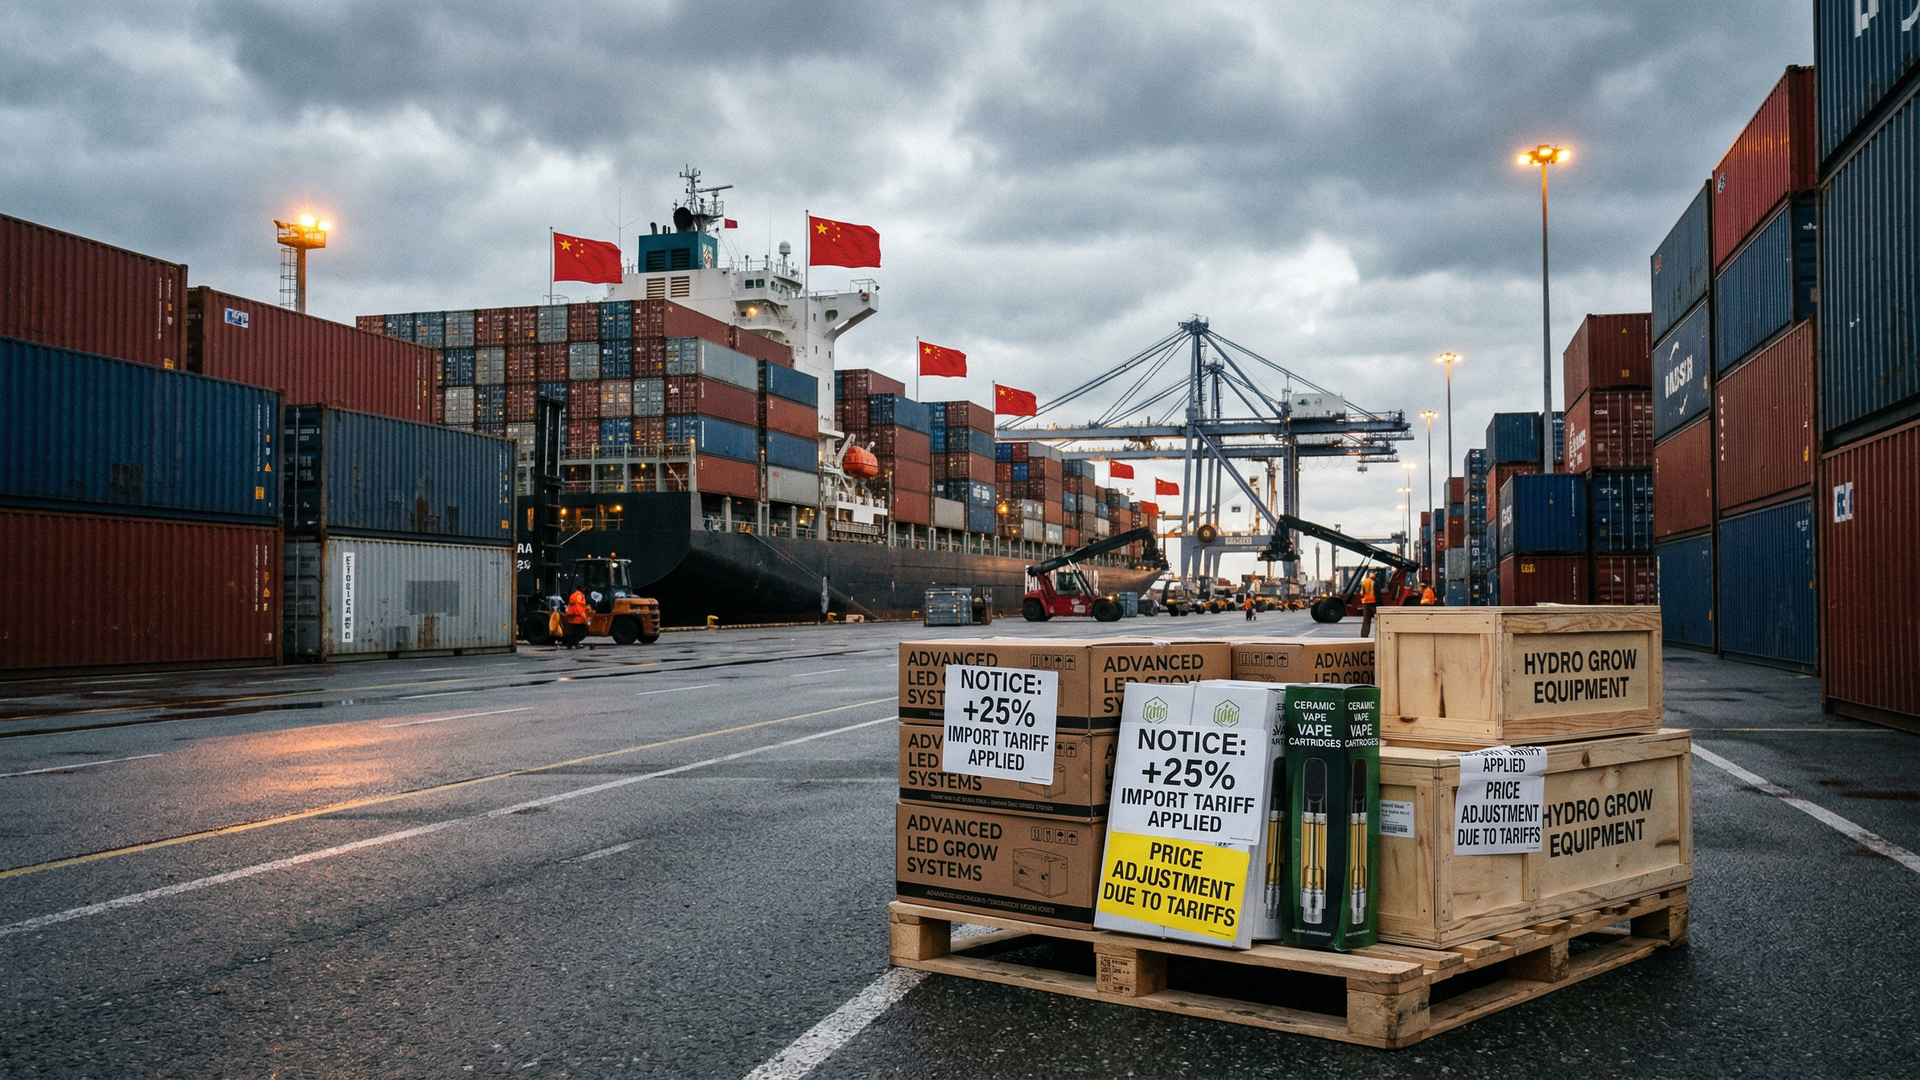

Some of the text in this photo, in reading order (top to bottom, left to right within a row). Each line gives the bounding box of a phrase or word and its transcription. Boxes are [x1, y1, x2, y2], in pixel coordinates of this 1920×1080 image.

[907, 651, 998, 667] ADVANCED
[1103, 654, 1204, 673] ADVANCED
[1314, 650, 1375, 669] ADVANCE
[1524, 649, 1637, 675] HYDRO GROW
[908, 670, 938, 686] LED
[961, 669, 1042, 695] NOTICE:
[907, 689, 945, 705] SYST
[1534, 676, 1629, 704] EQUIPMENT
[963, 696, 1036, 727] +25%
[1294, 700, 1336, 711] CERAMIC
[1348, 701, 1375, 711] CERAMIC
[1302, 712, 1327, 722] VAPE
[1354, 712, 1369, 721] VAPE
[948, 725, 999, 747] IMPORT
[1003, 730, 1049, 752] TARIFF
[1297, 723, 1333, 737] VAPE
[1350, 723, 1373, 737] VAPE
[1138, 728, 1246, 756] NOTICE:
[1288, 737, 1342, 748] CARTRIDGES
[908, 752, 939, 769] LED
[968, 749, 1025, 771] APPLIED
[1483, 757, 1526, 773] APPLIED
[908, 770, 982, 791] SYSTEMS
[1142, 757, 1235, 790] +25%
[1121, 788, 1255, 814] IMPORT TARIFF
[1486, 781, 1520, 800] PRICE
[1461, 804, 1539, 823] ADJUSTMENT
[1542, 789, 1653, 829] HYDRO GROW
[907, 814, 1003, 840] ADVANCED
[1147, 811, 1222, 833] APPLIED
[1458, 826, 1541, 846] DUE TO TARIFFS
[1550, 818, 1645, 858] EQUIPMENT
[907, 835, 998, 862] LED GROW
[1149, 842, 1203, 870] PRICE
[907, 857, 983, 882] SYSTEMS
[1111, 860, 1235, 901] ADJUSTMENT
[1103, 882, 1236, 927] DUE TO TARIFFS
